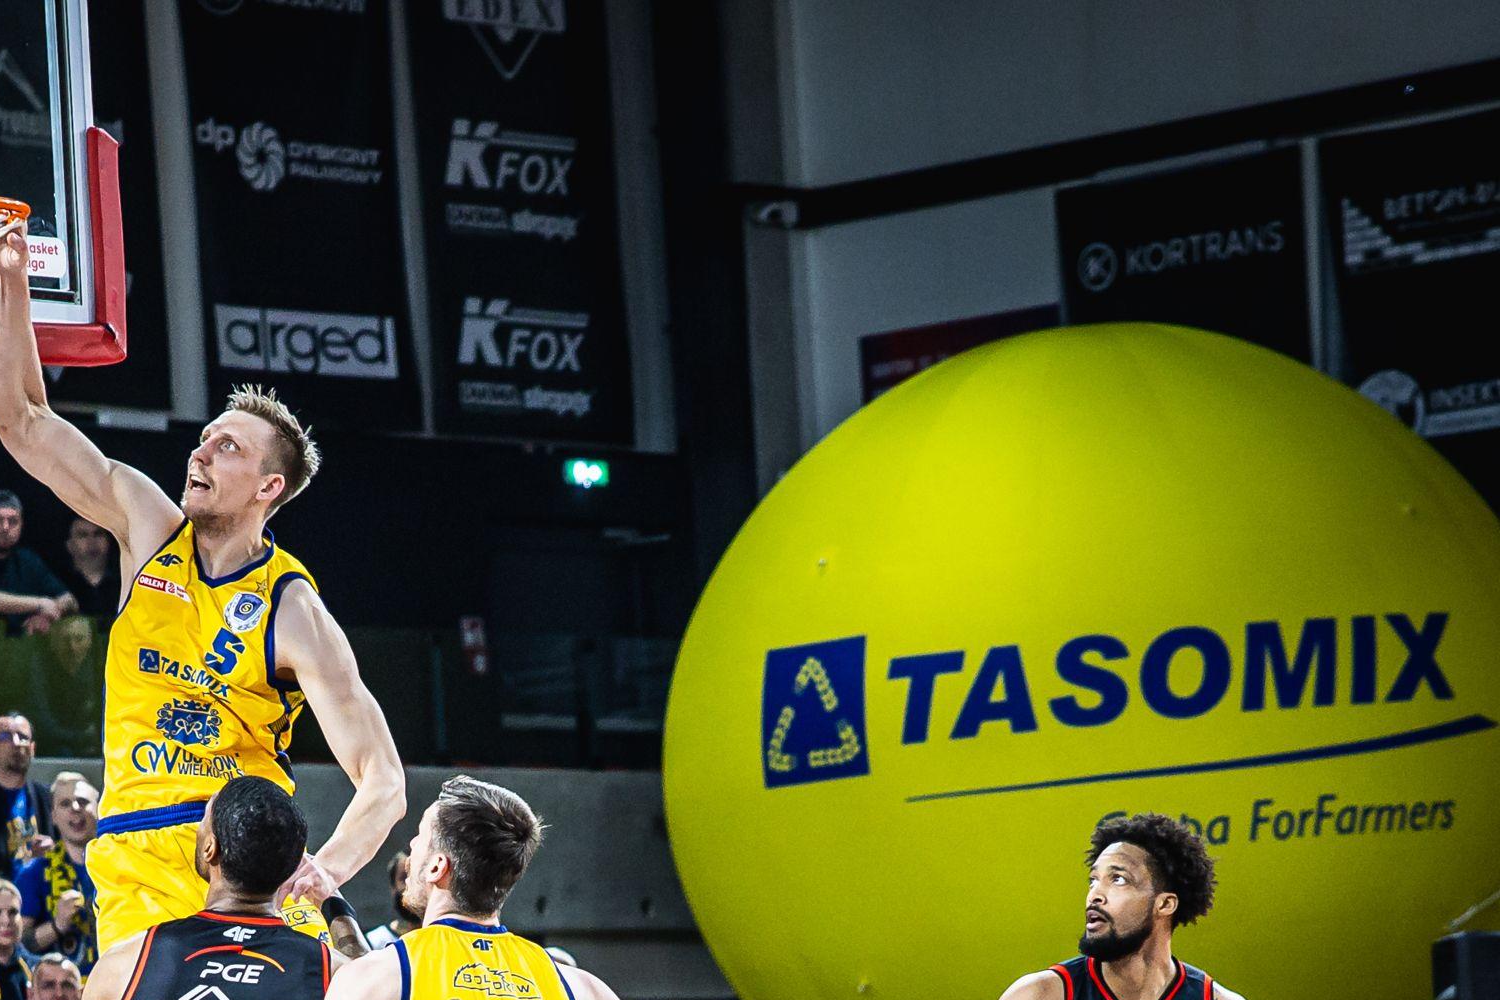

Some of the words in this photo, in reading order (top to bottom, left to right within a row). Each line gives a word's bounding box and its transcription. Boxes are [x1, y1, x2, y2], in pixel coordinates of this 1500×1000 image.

[29, 242, 58, 256] asket
[1126, 221, 1286, 277] KORTRANS
[225, 318, 388, 373] arged
[139, 575, 164, 589] ORLEN
[204, 627, 245, 676] 5
[888, 611, 1454, 745] TASOMIX
[1249, 794, 1456, 842] ForFarmers
[200, 961, 265, 984] PGE
